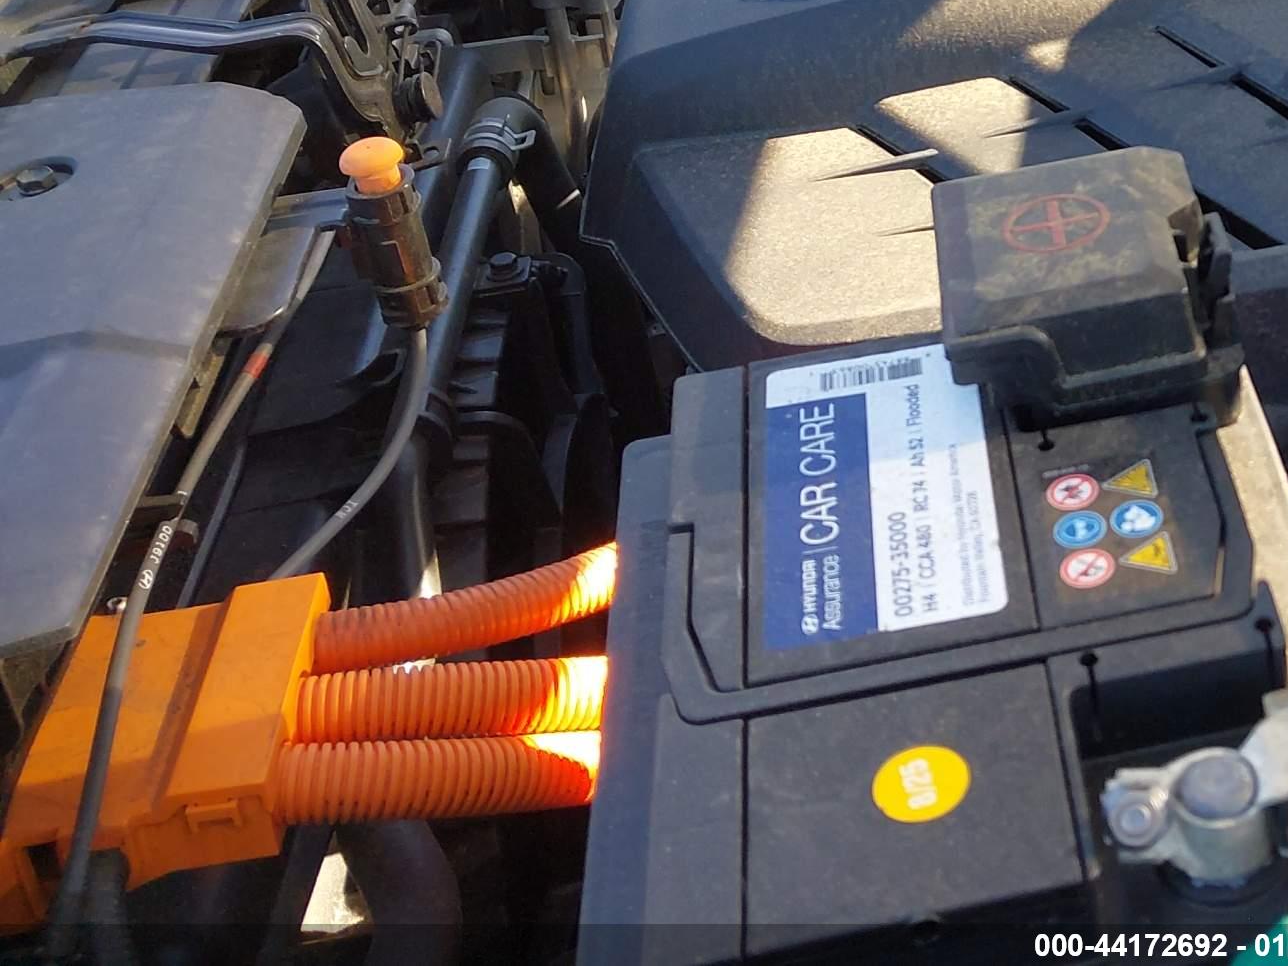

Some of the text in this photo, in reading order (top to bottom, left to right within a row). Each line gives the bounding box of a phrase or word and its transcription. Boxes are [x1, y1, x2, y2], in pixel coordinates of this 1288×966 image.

[905, 383, 922, 426] Flooded
[799, 402, 839, 545] CAR CARE
[912, 494, 929, 512] RC
[915, 524, 931, 548] 480
[888, 512, 913, 617] 00275-35000
[918, 551, 936, 579] CCA
[802, 559, 817, 614] HYUNDAI
[822, 554, 842, 630] Assurance
[921, 593, 938, 612] H4
